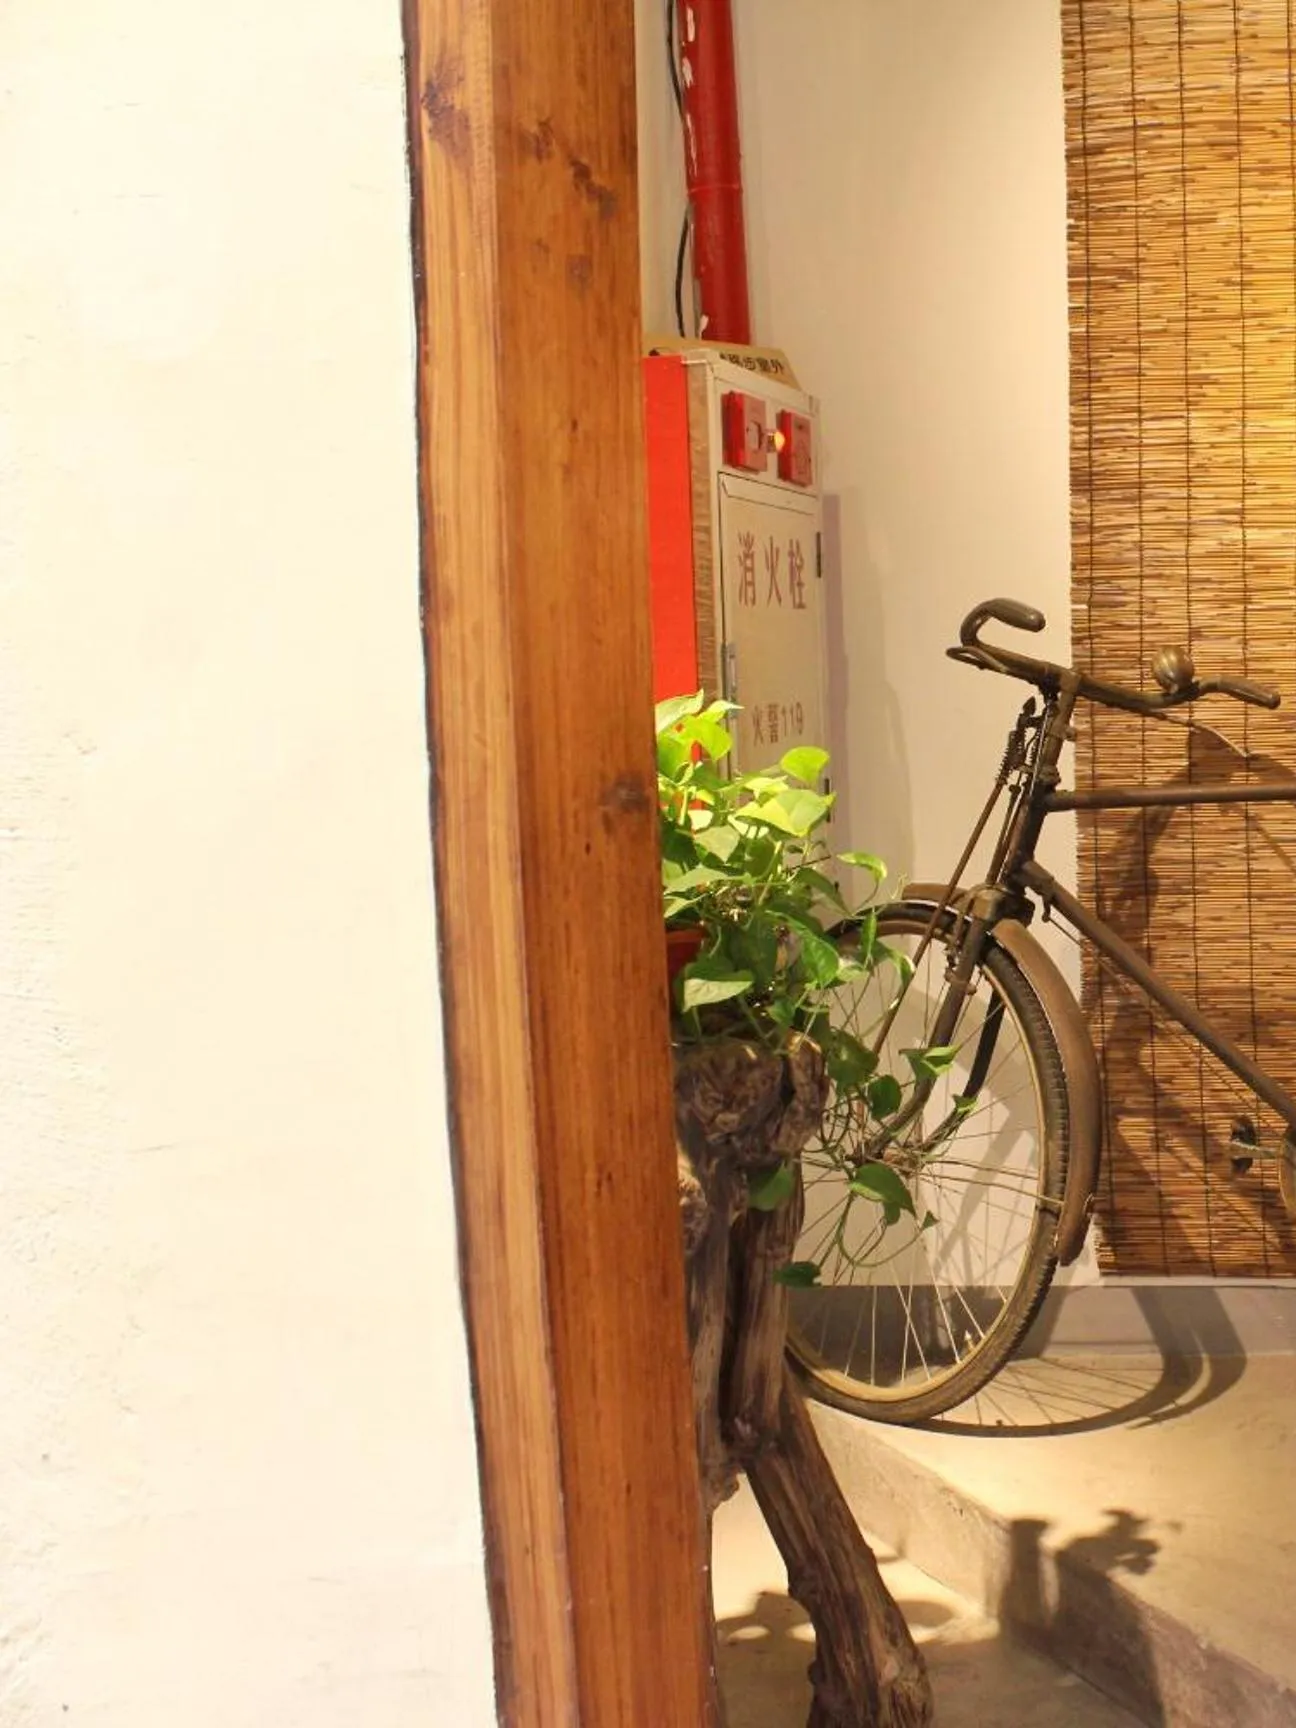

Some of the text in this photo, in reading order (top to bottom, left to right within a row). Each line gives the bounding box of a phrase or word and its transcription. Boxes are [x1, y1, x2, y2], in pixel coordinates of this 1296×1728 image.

[737, 532, 807, 610] 消火栓
[752, 701, 804, 747] 火警119
